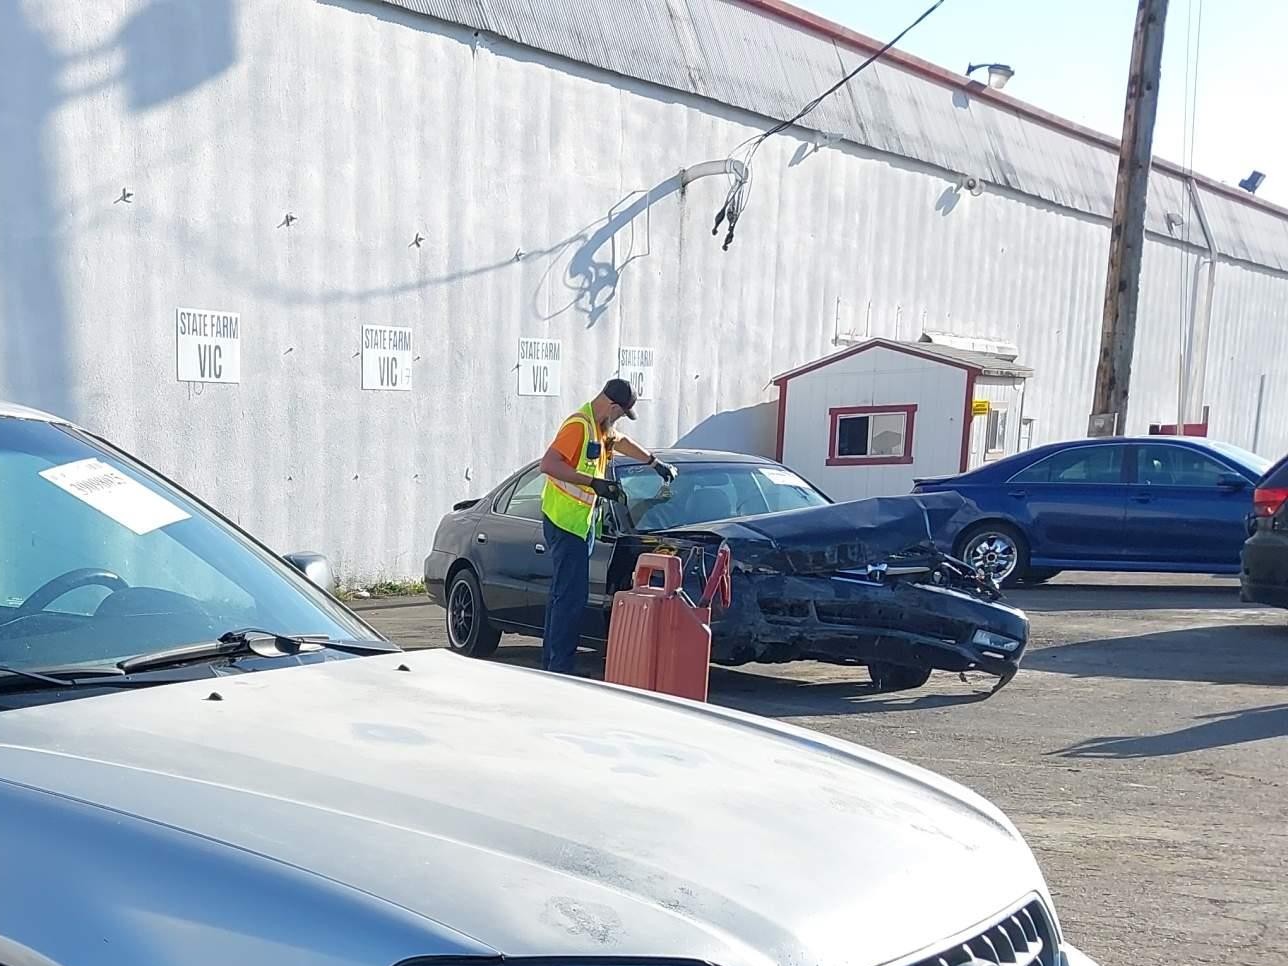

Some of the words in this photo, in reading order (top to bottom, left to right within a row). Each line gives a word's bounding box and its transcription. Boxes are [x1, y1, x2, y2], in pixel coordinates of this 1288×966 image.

[180, 312, 208, 336] STATE
[211, 315, 238, 339] FARM
[365, 328, 386, 350] STATE
[389, 330, 411, 351] FARM
[521, 341, 540, 359] STATE
[542, 343, 560, 360] FARM
[198, 344, 222, 378] VIC
[379, 356, 397, 386] VIC
[533, 365, 548, 392] VIC
